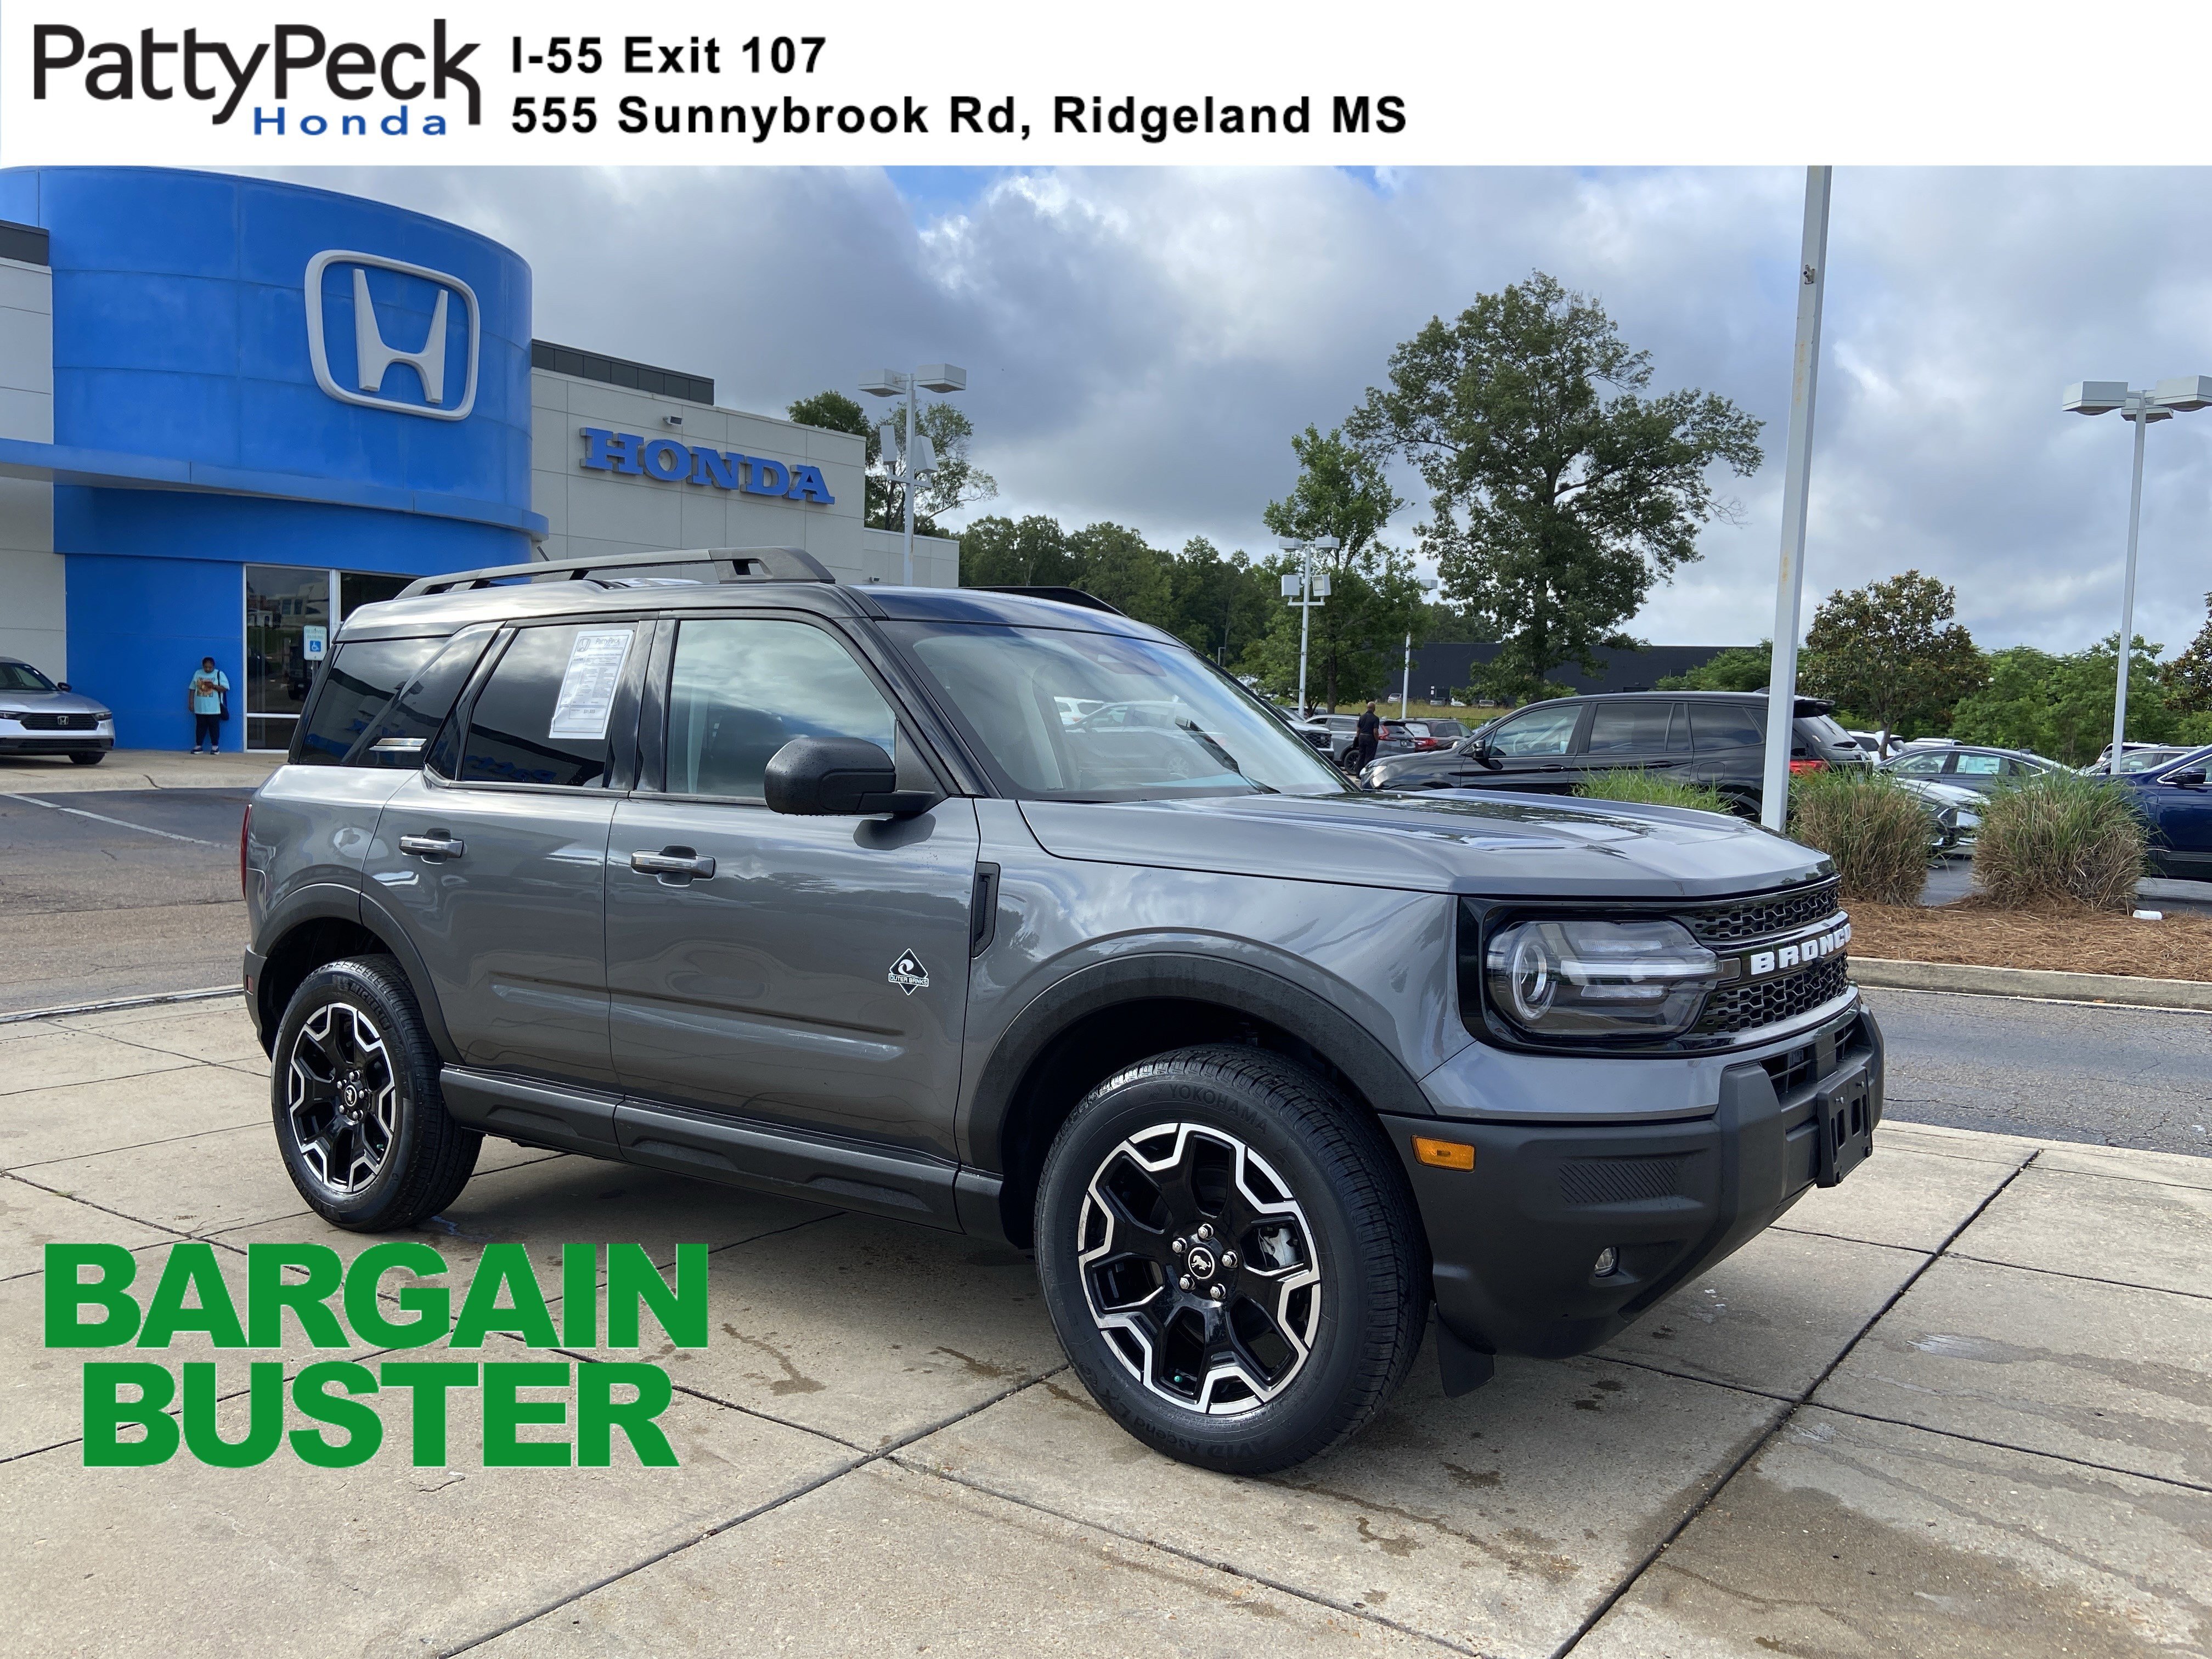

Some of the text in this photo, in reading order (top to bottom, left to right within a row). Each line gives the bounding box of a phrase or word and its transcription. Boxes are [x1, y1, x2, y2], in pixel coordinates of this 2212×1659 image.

[579, 427, 835, 505] HONDA
[1750, 923, 1852, 975] BRONCO
[349, 982, 391, 1029] MICHELIN
[1169, 1083, 1268, 1136] YOKOHAMA
[1098, 1387, 1132, 1419] LX
[1132, 1416, 1199, 1454] Ascend
